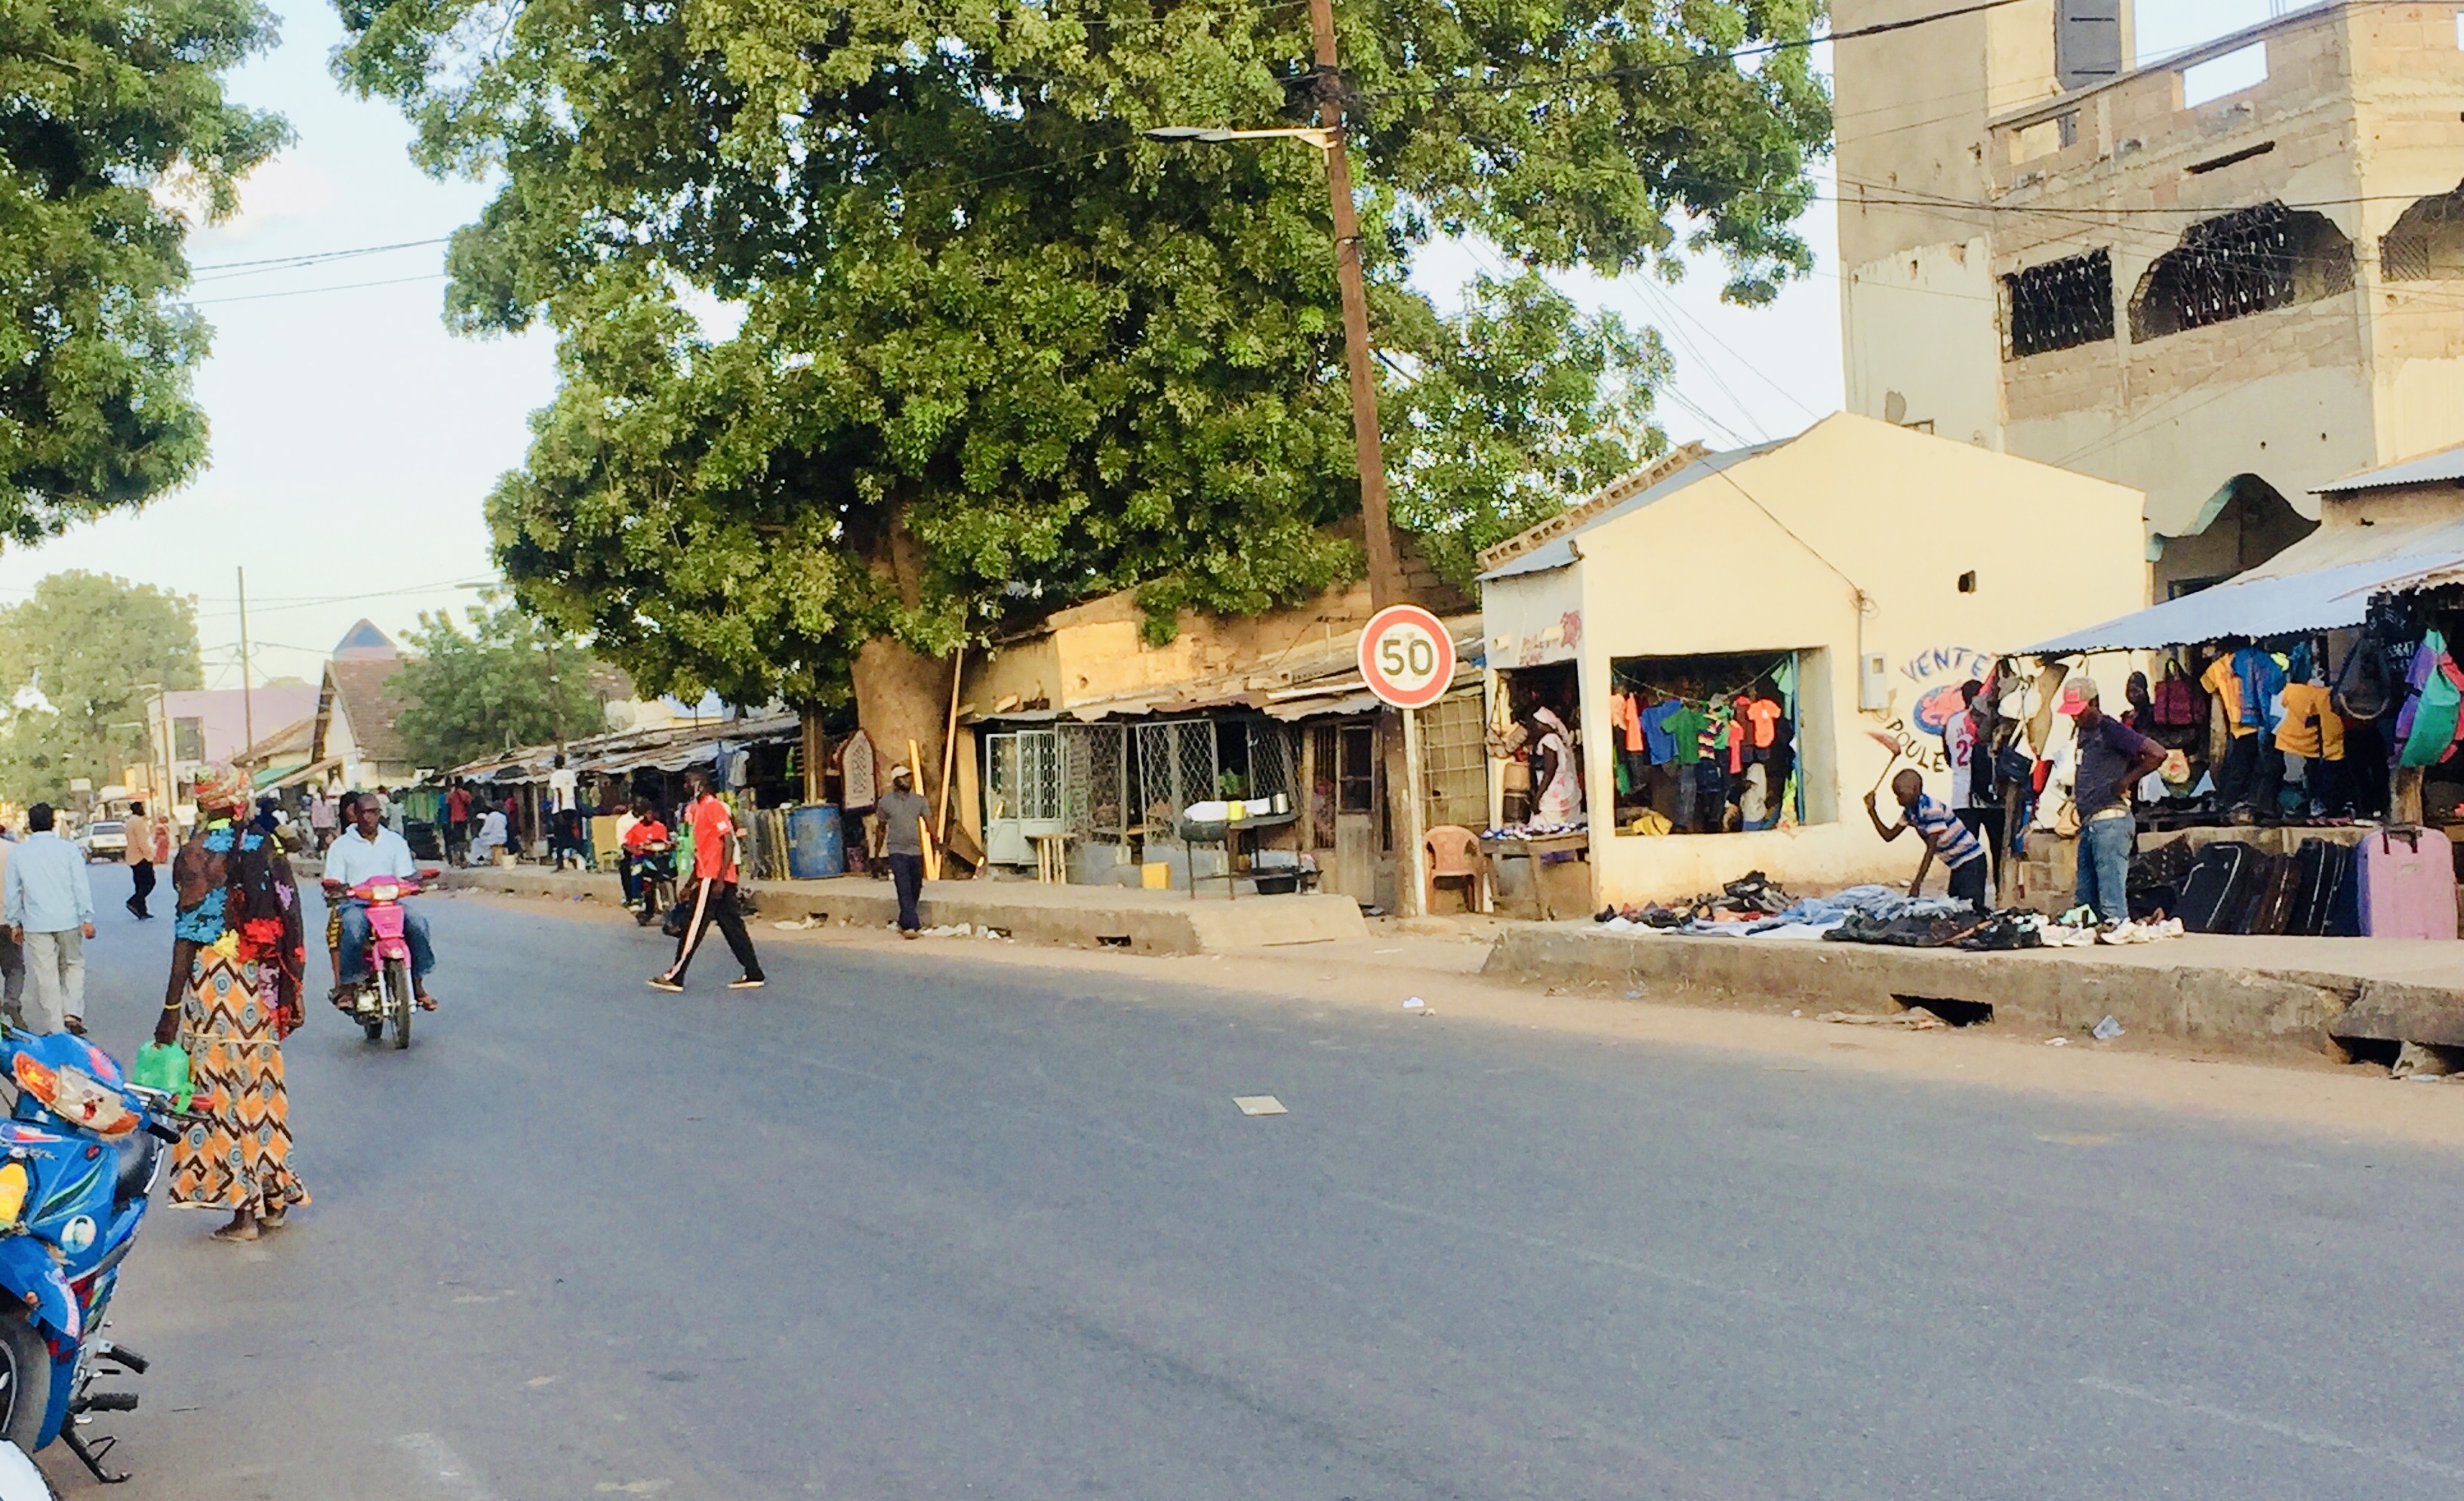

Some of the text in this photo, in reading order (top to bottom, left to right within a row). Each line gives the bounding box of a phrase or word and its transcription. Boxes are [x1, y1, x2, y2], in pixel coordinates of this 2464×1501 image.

[1382, 639, 1434, 677] 50
[1899, 646, 1991, 683] VENTE
[1885, 718, 1945, 773] POULE
